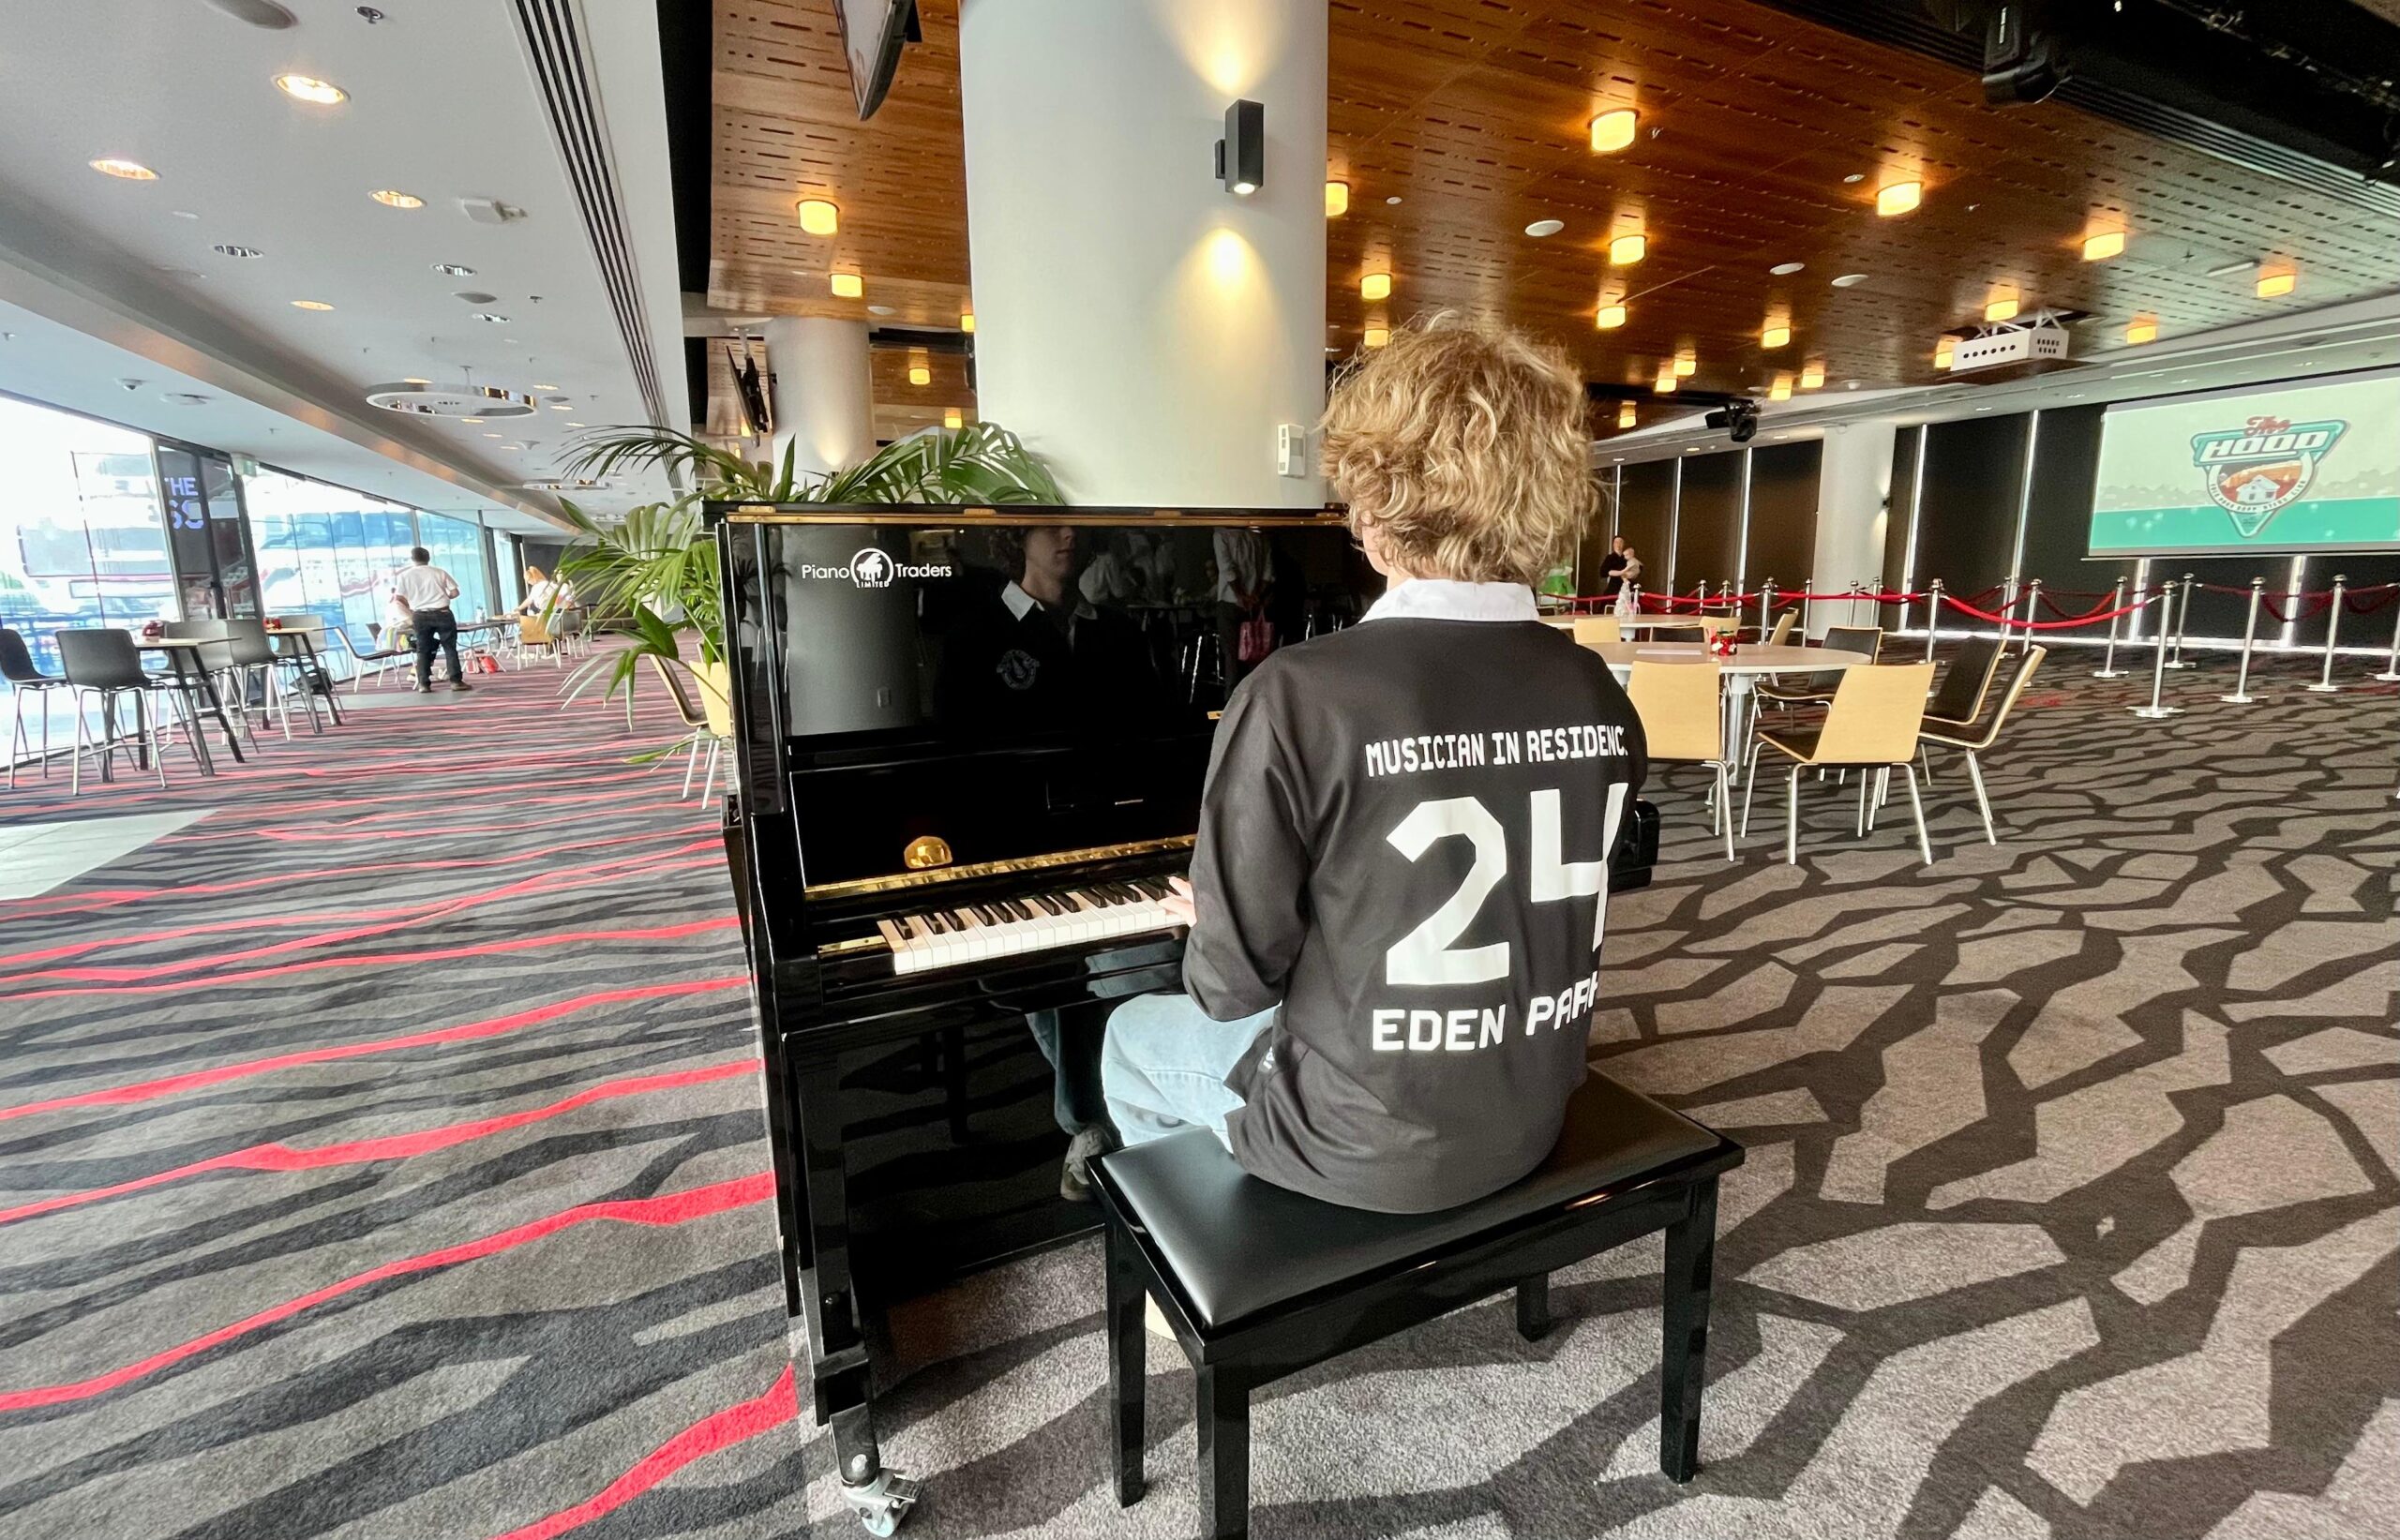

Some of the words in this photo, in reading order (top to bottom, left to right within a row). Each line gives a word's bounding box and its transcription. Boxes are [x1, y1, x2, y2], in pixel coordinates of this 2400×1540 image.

[2199, 430, 2330, 462] HOOD
[164, 476, 199, 496] HE
[802, 563, 850, 579] Piano
[894, 562, 952, 577] Traders
[856, 580, 890, 589] LIMITED
[1365, 732, 1485, 777] MUSICIAN
[1492, 731, 1521, 765] IN
[1527, 725, 1628, 763] RESIDENC
[1386, 782, 1628, 985] 24
[1372, 1004, 1506, 1051] EDEN
